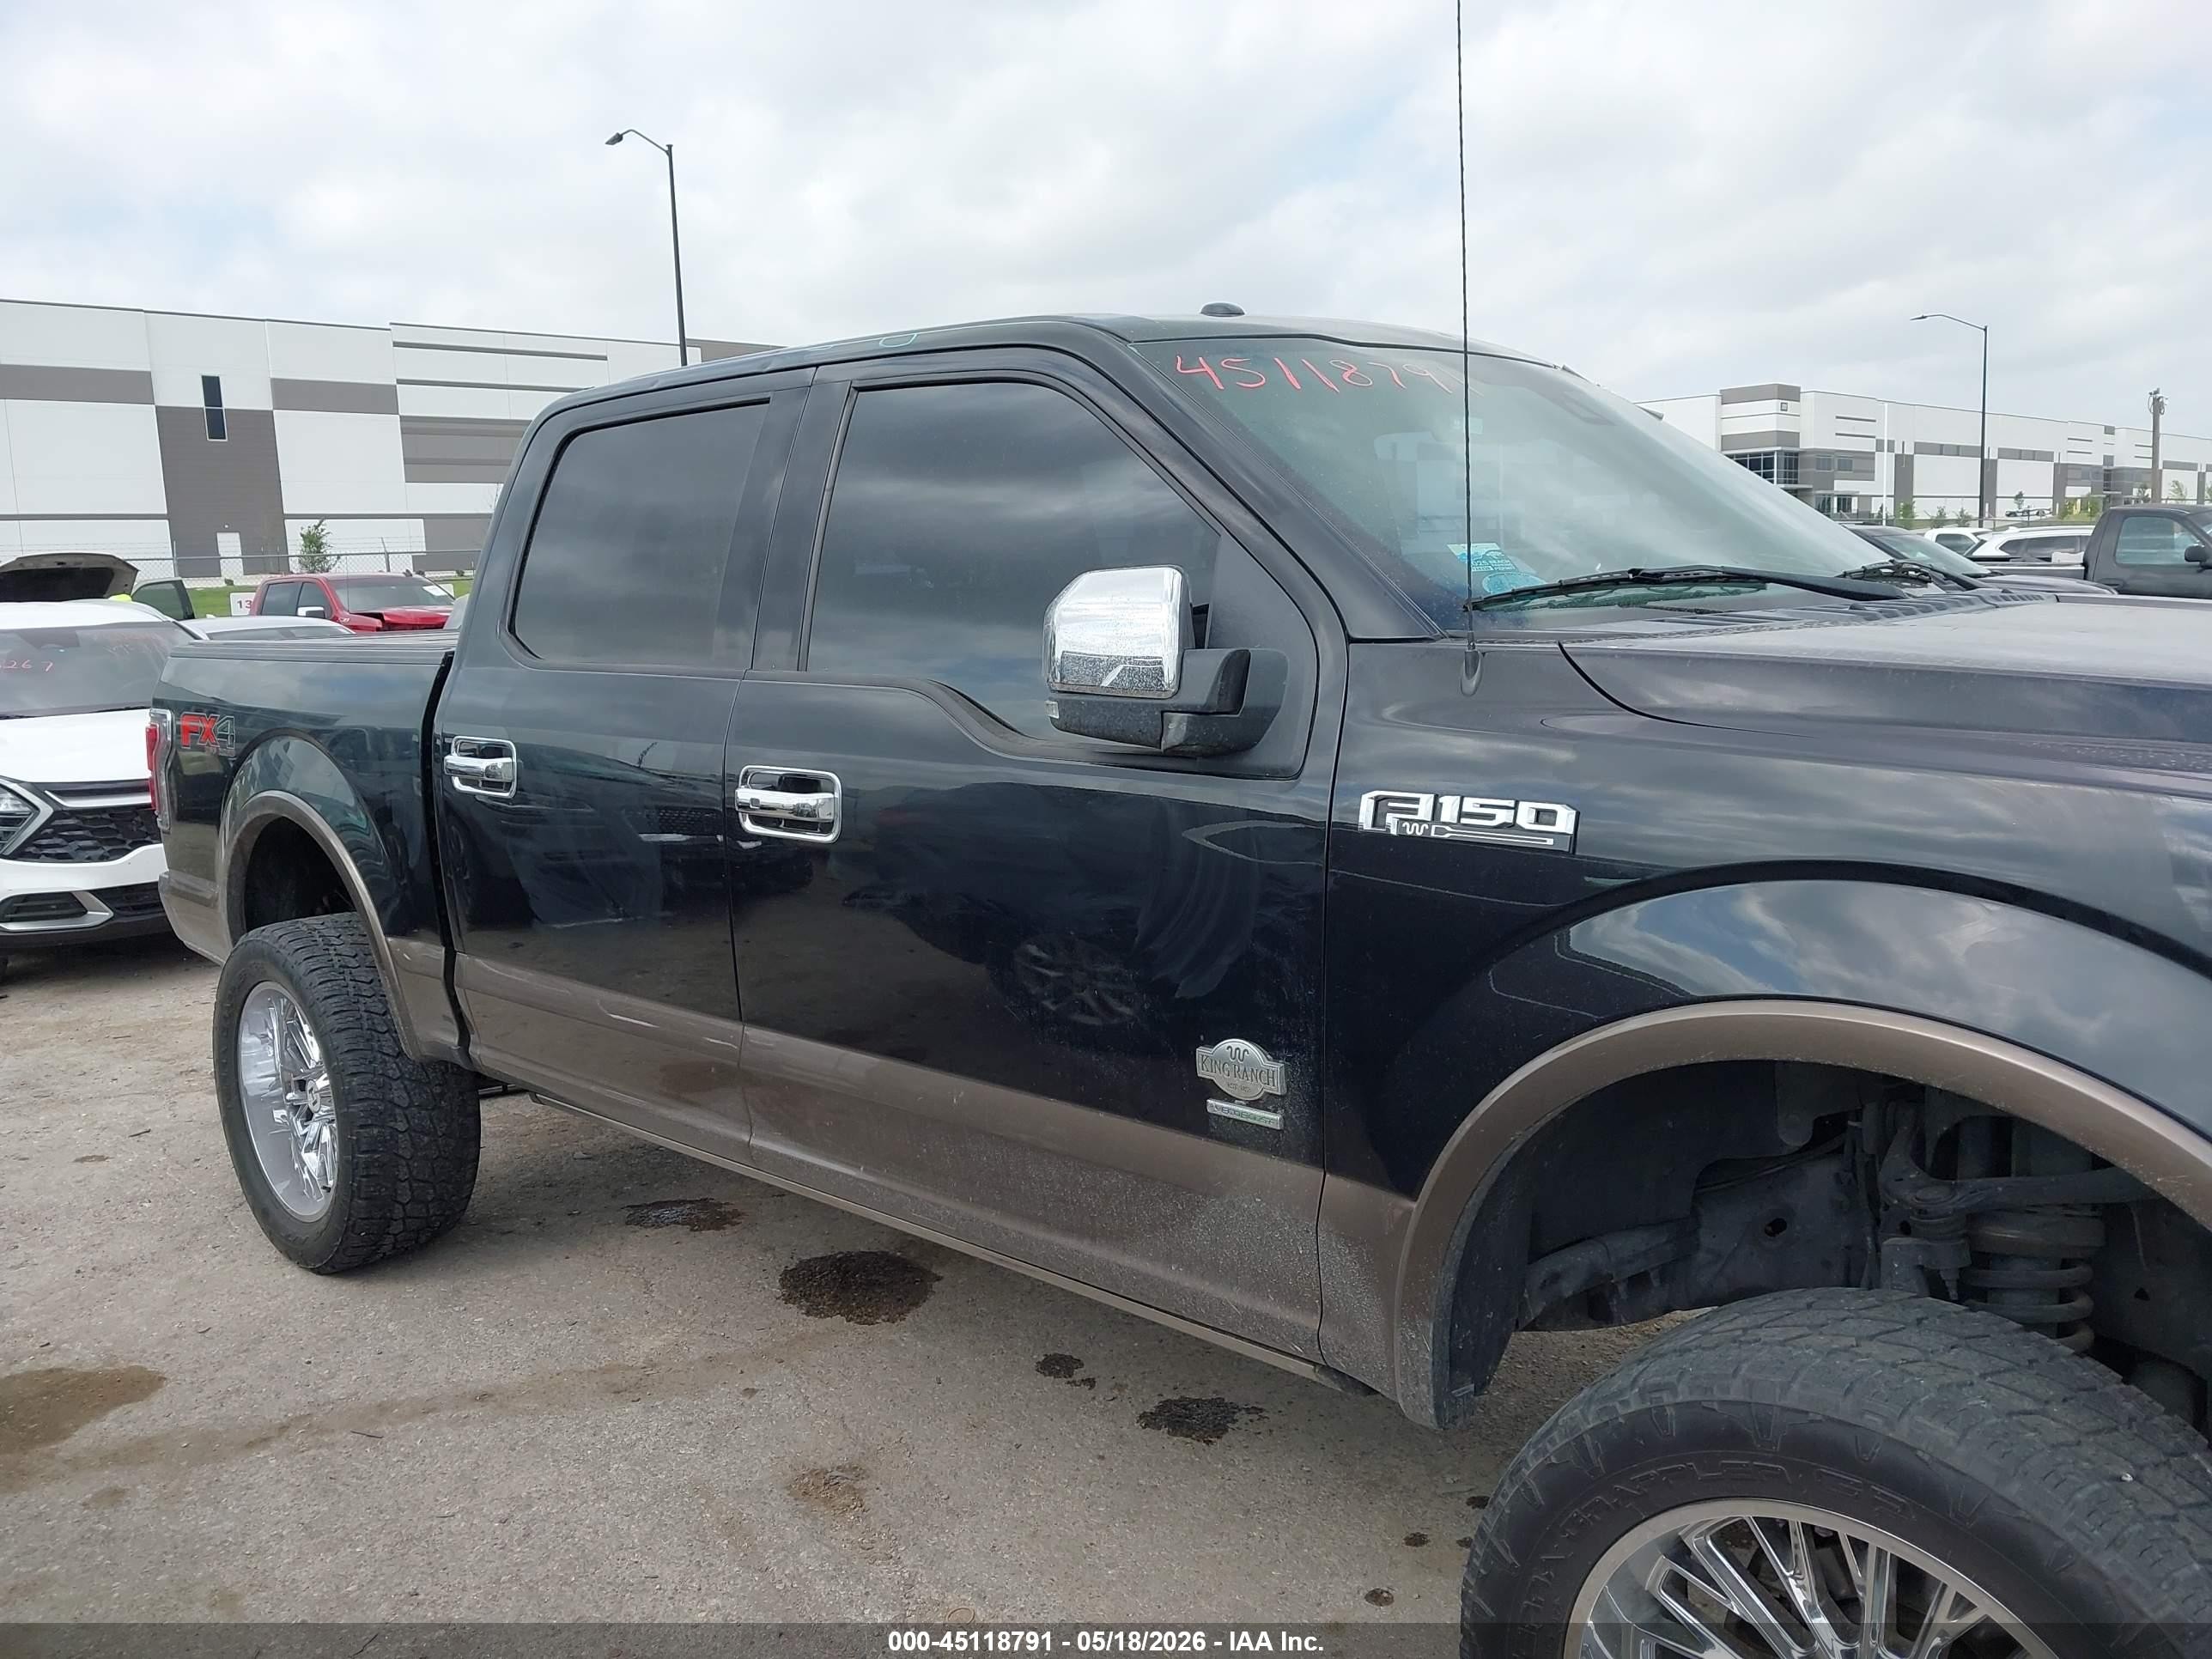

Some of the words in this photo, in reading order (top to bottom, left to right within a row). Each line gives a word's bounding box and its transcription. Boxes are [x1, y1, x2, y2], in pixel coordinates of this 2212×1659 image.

[180, 711, 236, 750] FX4
[1200, 1054, 1231, 1078] KING
[1233, 1064, 1276, 1087] RANCH
